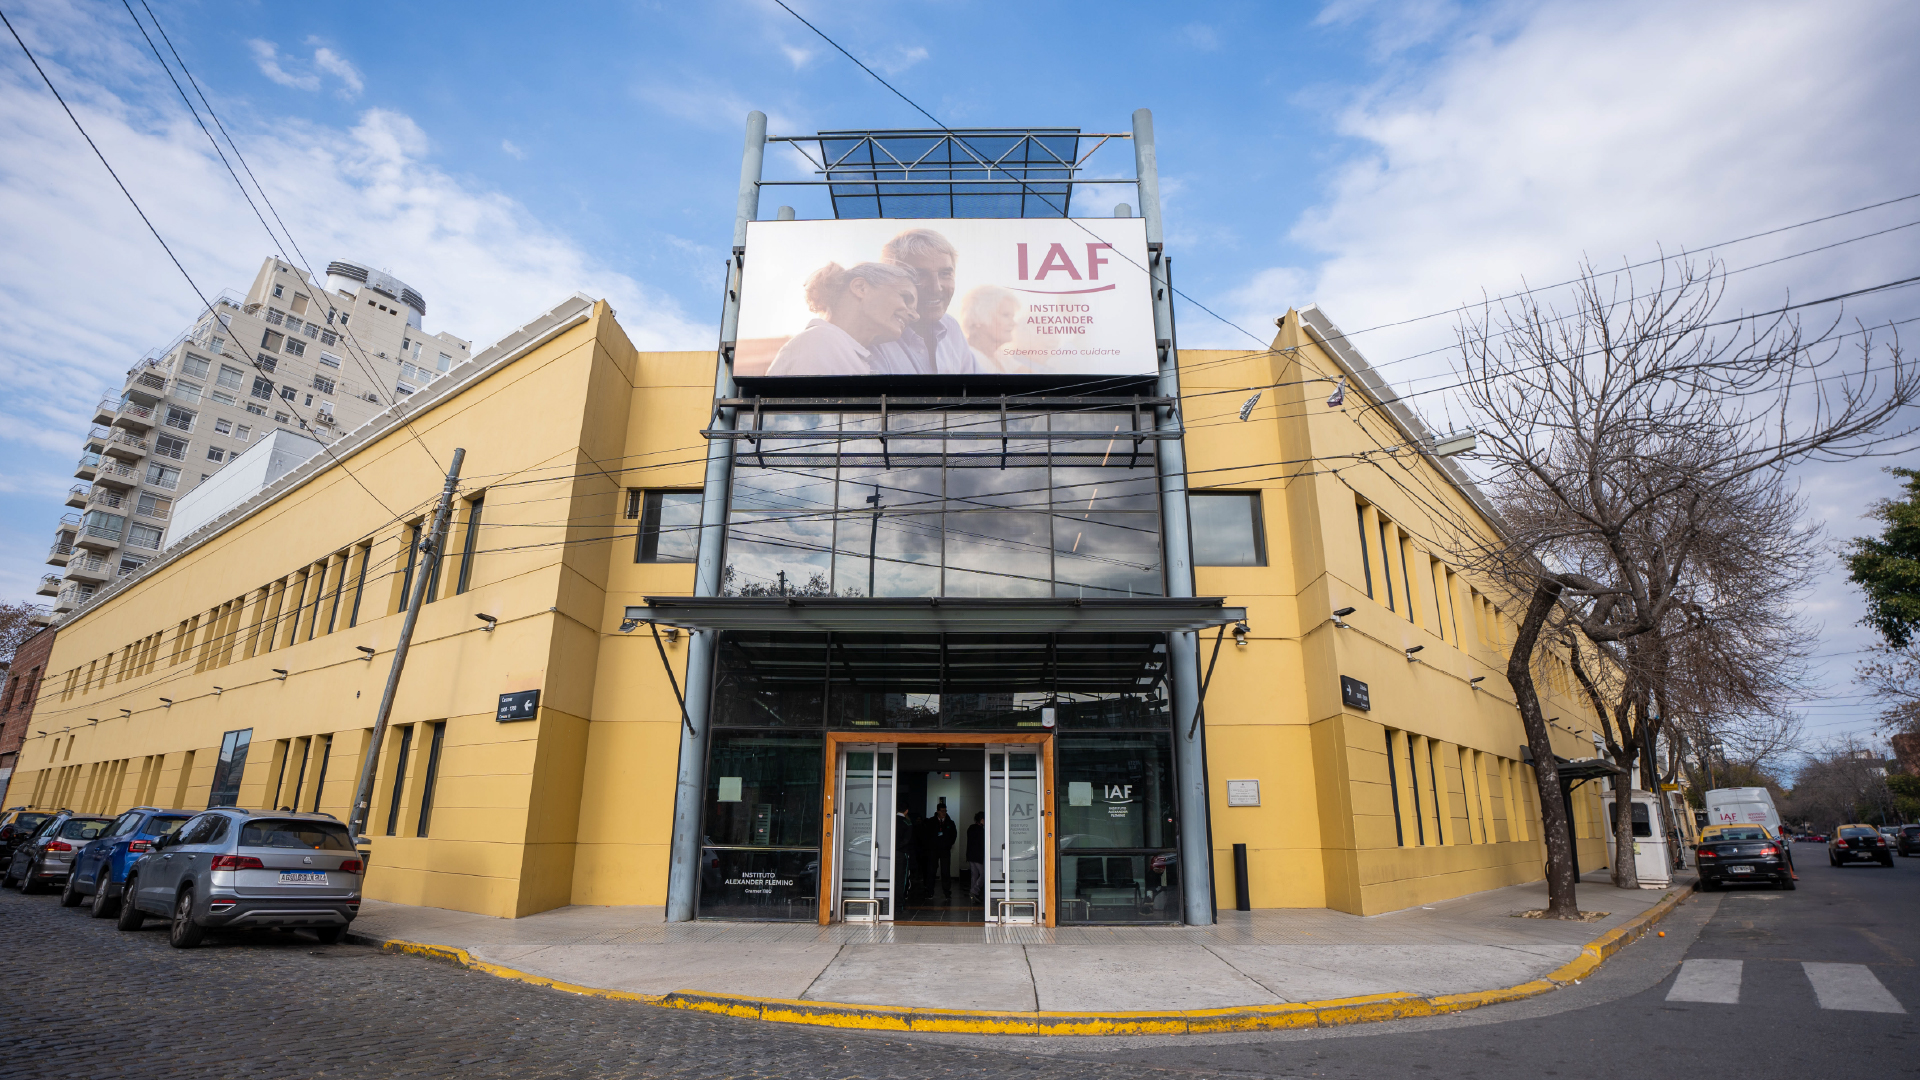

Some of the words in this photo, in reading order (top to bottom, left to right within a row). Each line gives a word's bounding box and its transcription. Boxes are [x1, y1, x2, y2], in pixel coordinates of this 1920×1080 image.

[1016, 242, 1113, 281] IAF
[1029, 304, 1090, 313] INSTITUTO
[1027, 315, 1094, 325] ALEXANDER
[1036, 325, 1086, 335] FLEMING
[1003, 348, 1048, 356] Sabemos
[1080, 347, 1121, 356] cuidarte
[1104, 784, 1133, 799] IAF
[849, 802, 873, 815] IA
[1720, 812, 1737, 821] IAF
